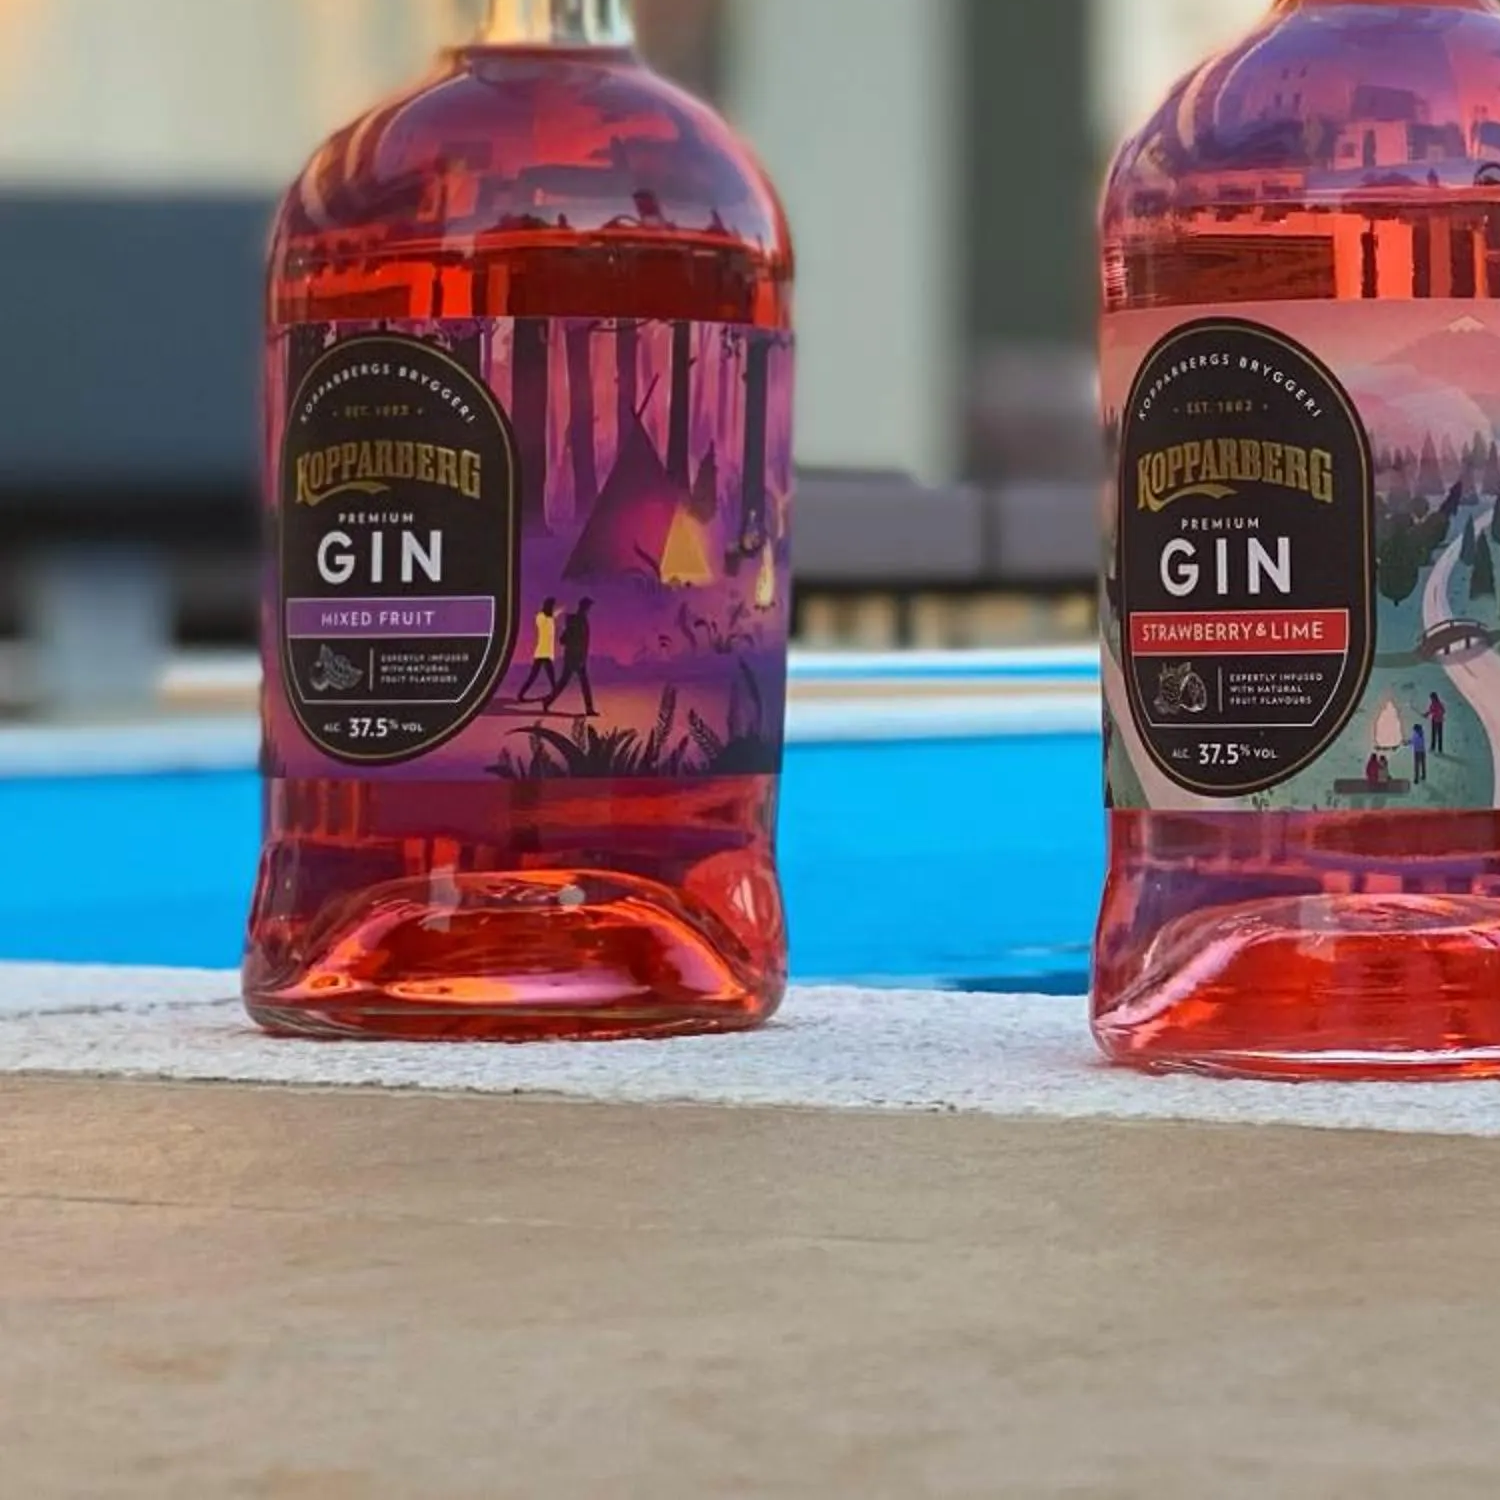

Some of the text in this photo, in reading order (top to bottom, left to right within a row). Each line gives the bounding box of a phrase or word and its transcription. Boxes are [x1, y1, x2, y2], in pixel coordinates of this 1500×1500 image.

[1138, 353, 1323, 421] KOPPARBERGS BRYGGERI
[294, 440, 482, 507] KOPPARBERG
[1136, 438, 1334, 512] KOPPARBERG
[338, 513, 414, 524] PREMIUM
[1181, 517, 1260, 531] PREMIUM
[317, 529, 442, 585] GIN
[1160, 537, 1291, 597] GIN
[320, 611, 436, 626] MIXED FRUIT
